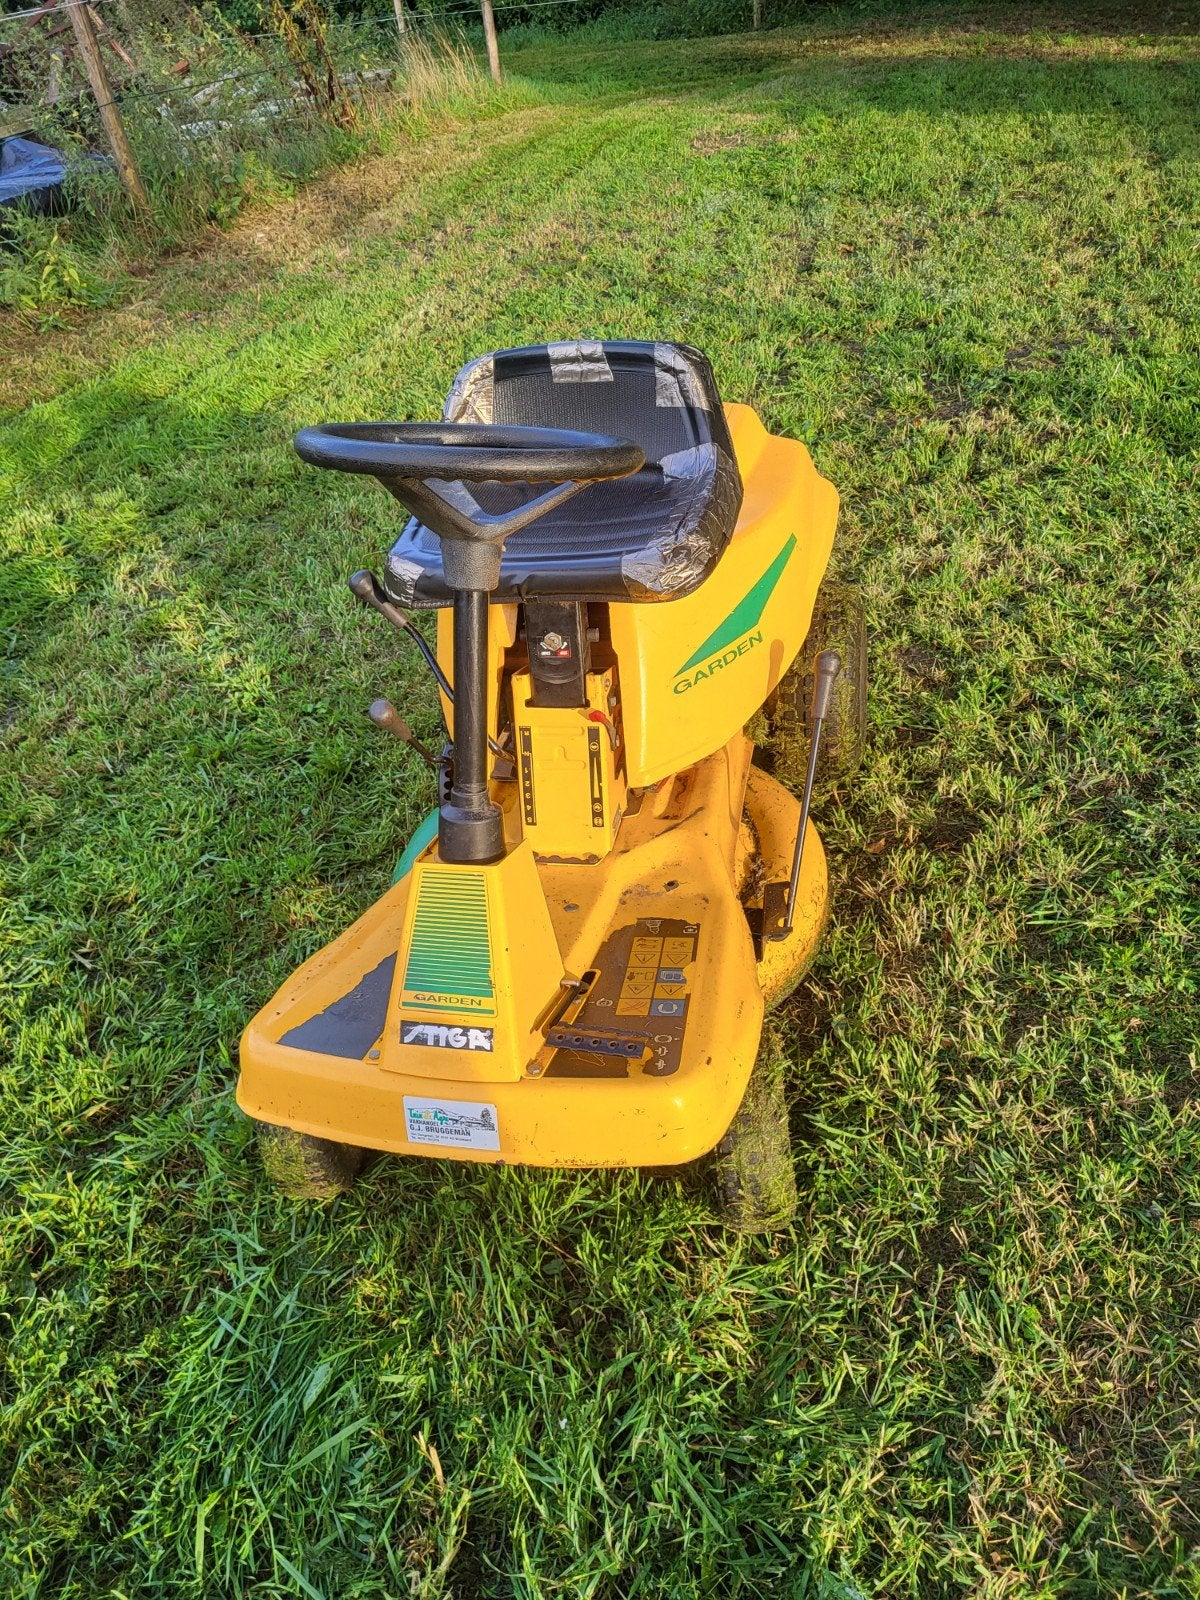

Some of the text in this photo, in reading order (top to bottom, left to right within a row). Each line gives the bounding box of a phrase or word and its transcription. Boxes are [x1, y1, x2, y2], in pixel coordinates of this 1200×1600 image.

[673, 630, 763, 694] GARDEN
[413, 993, 482, 1006] GARDEN
[403, 1024, 491, 1051] STIGA
[425, 1126, 471, 1137] BRUGGEMAN
